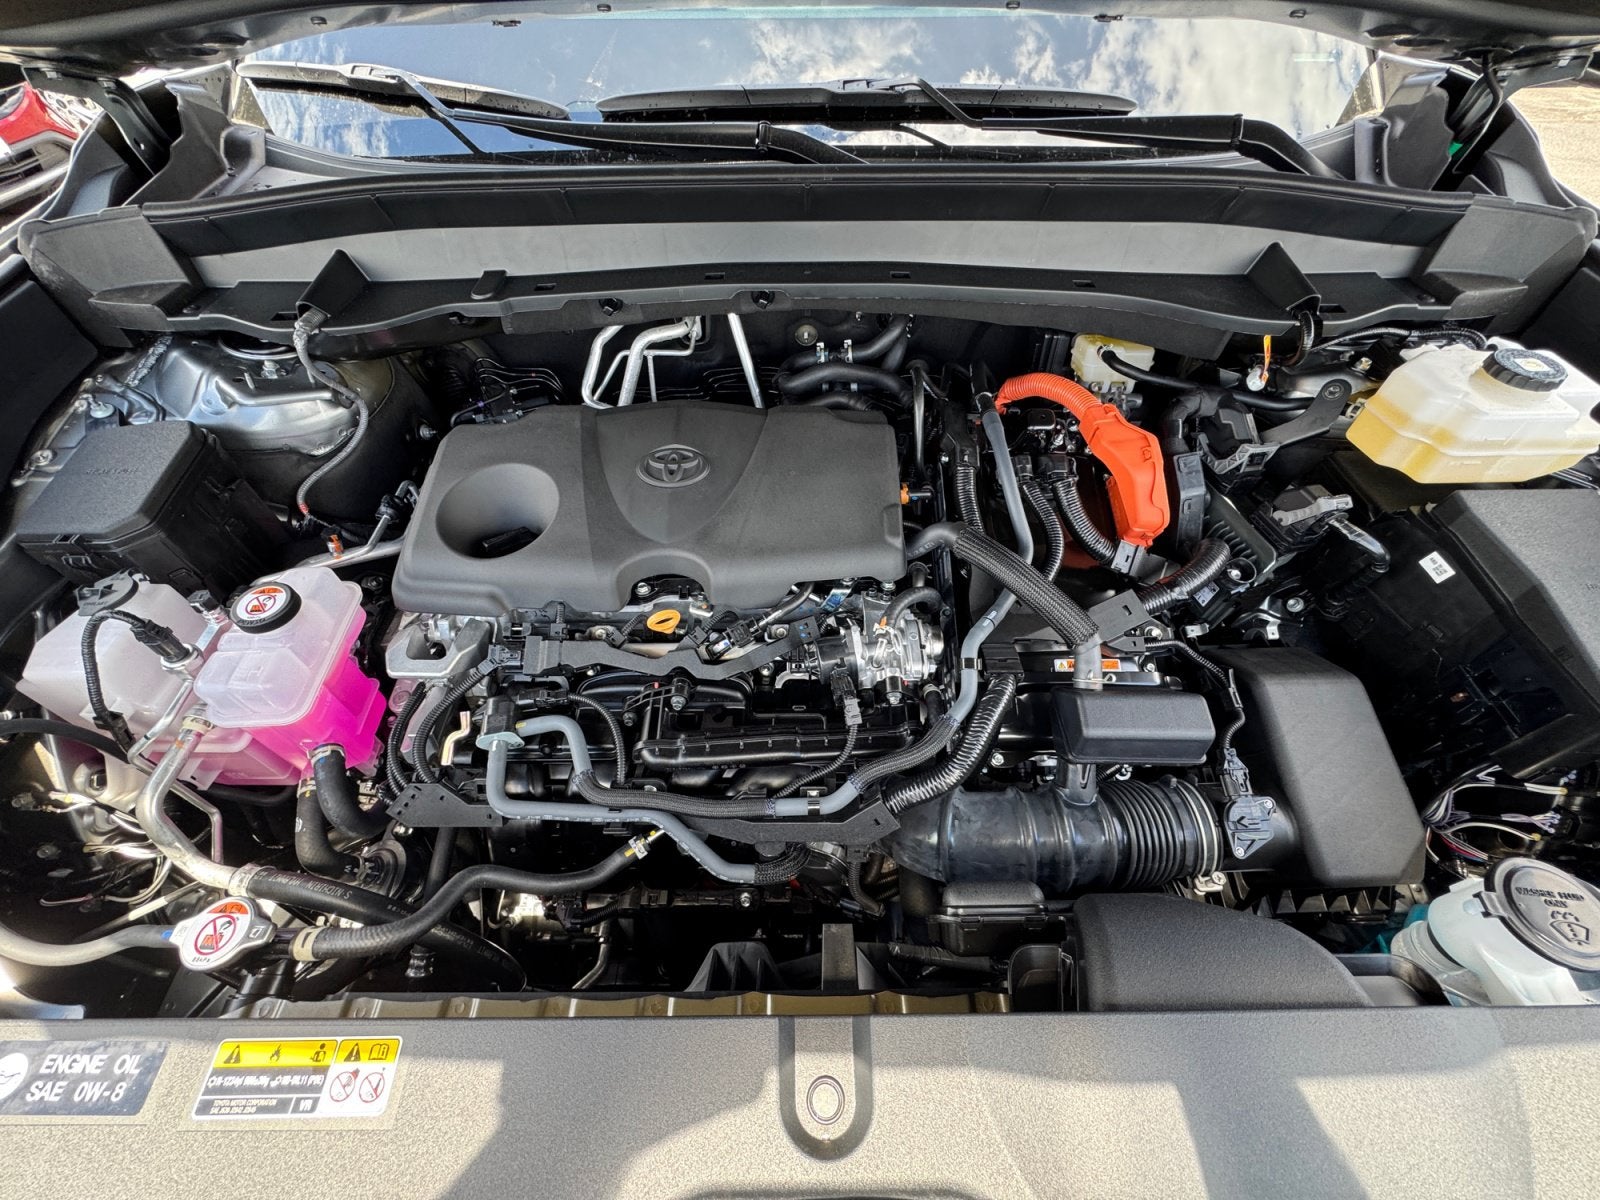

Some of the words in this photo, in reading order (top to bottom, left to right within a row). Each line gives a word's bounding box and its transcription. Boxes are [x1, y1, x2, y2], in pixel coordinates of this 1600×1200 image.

[39, 1054, 111, 1074] ENGINE
[113, 1054, 142, 1074] OIL
[25, 1081, 69, 1102] SAE
[73, 1081, 128, 1102] 0W-8
